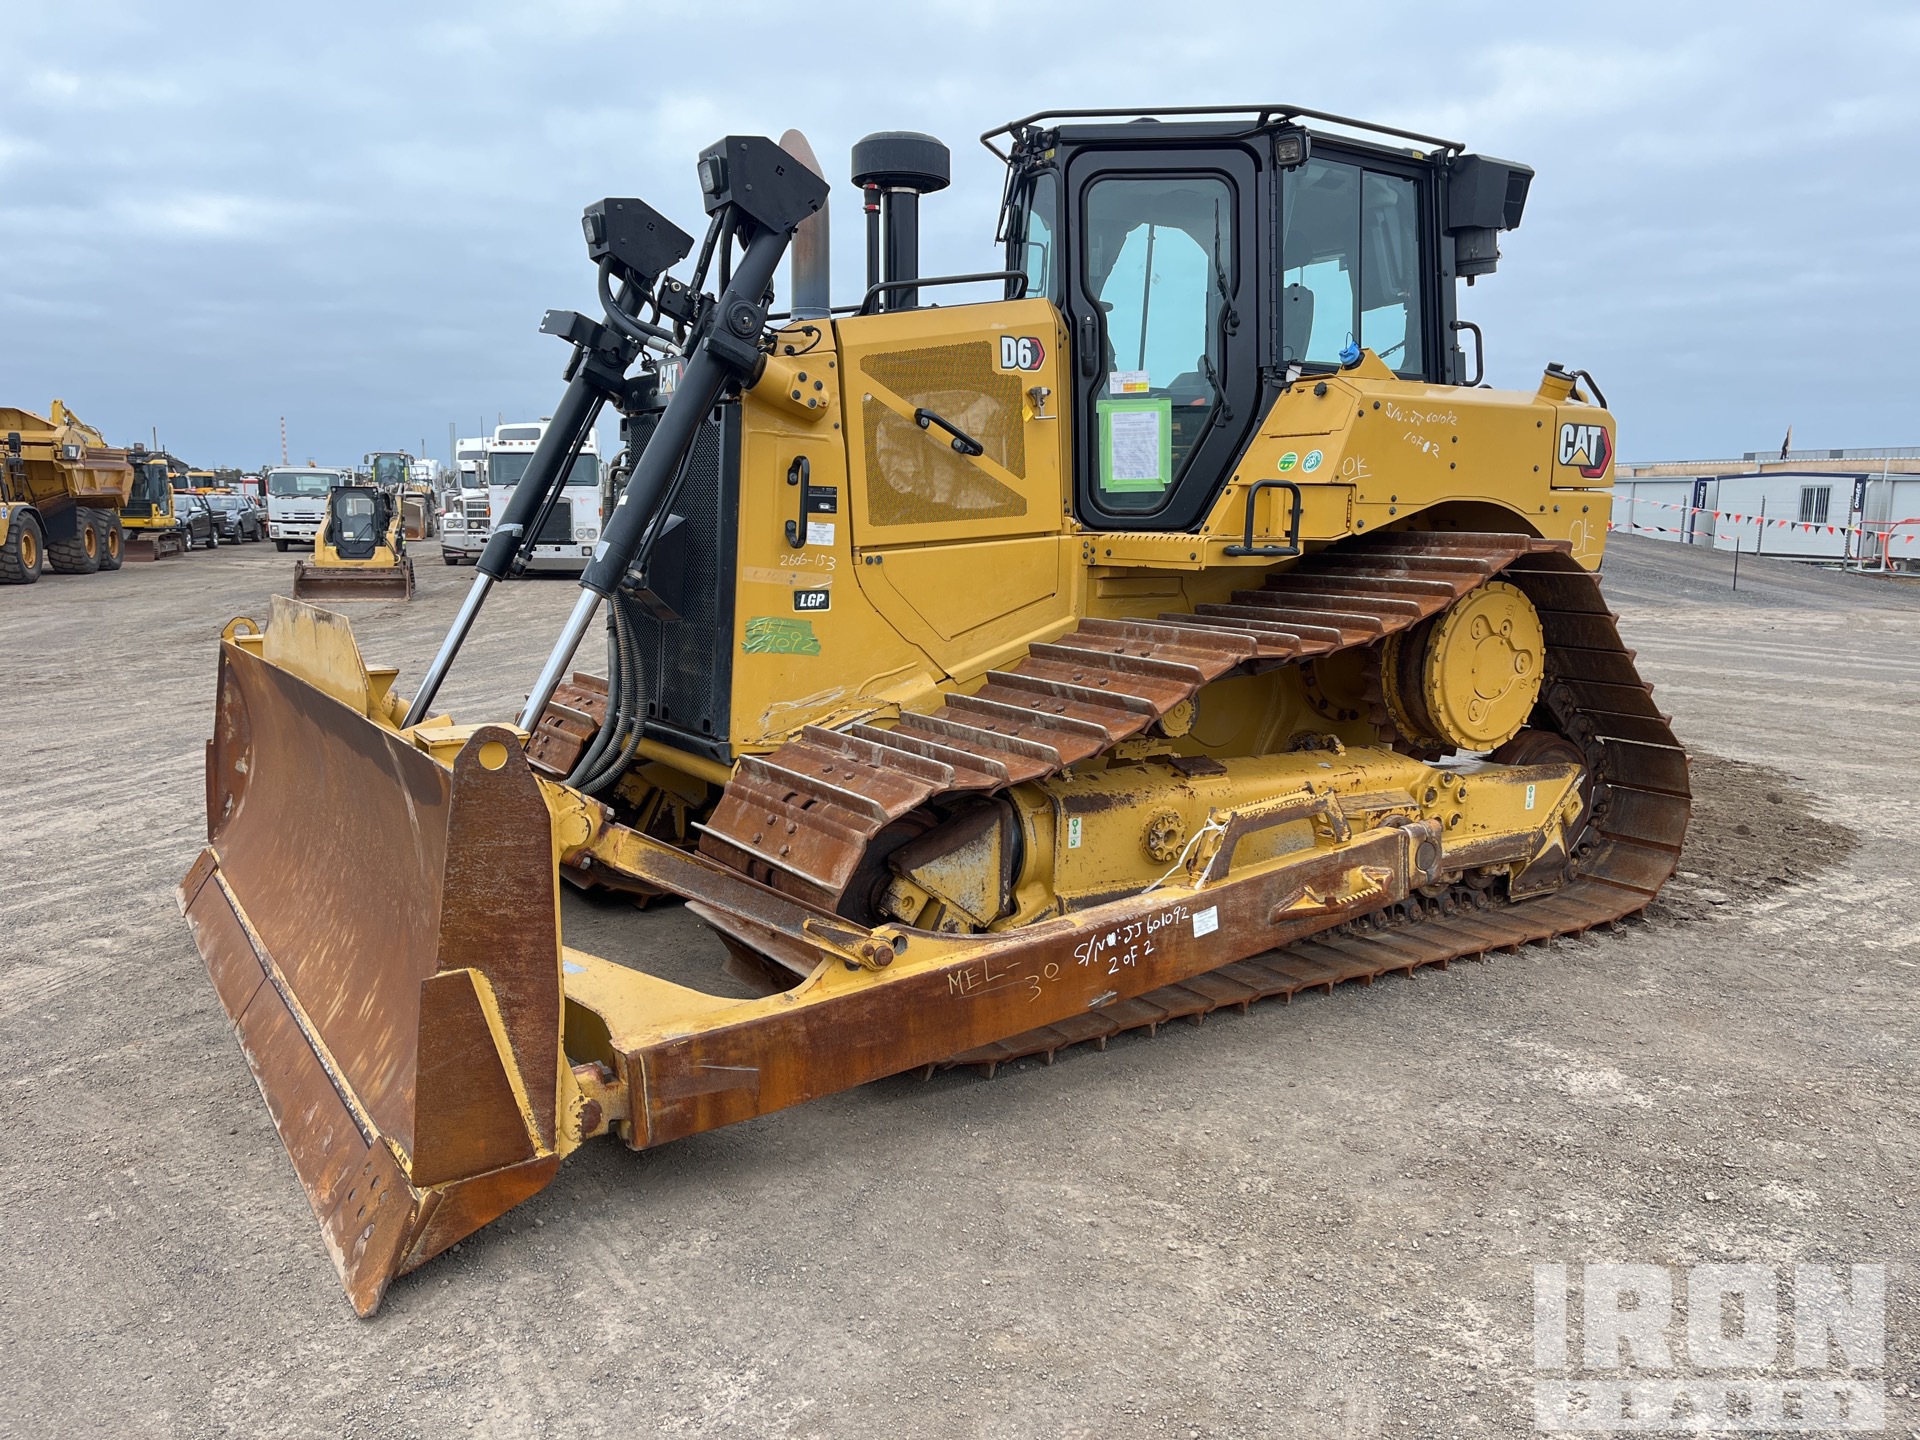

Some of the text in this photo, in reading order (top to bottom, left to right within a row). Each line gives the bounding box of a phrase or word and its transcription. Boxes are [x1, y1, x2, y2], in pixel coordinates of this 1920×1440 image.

[1001, 337, 1031, 368] D6
[659, 363, 678, 393] CAT
[1559, 423, 1601, 466] CAT
[1342, 454, 1368, 477] OK
[799, 593, 826, 608] LGP
[768, 631, 817, 653] 1092
[1108, 957, 1120, 975] 2
[1144, 940, 1155, 956] 2
